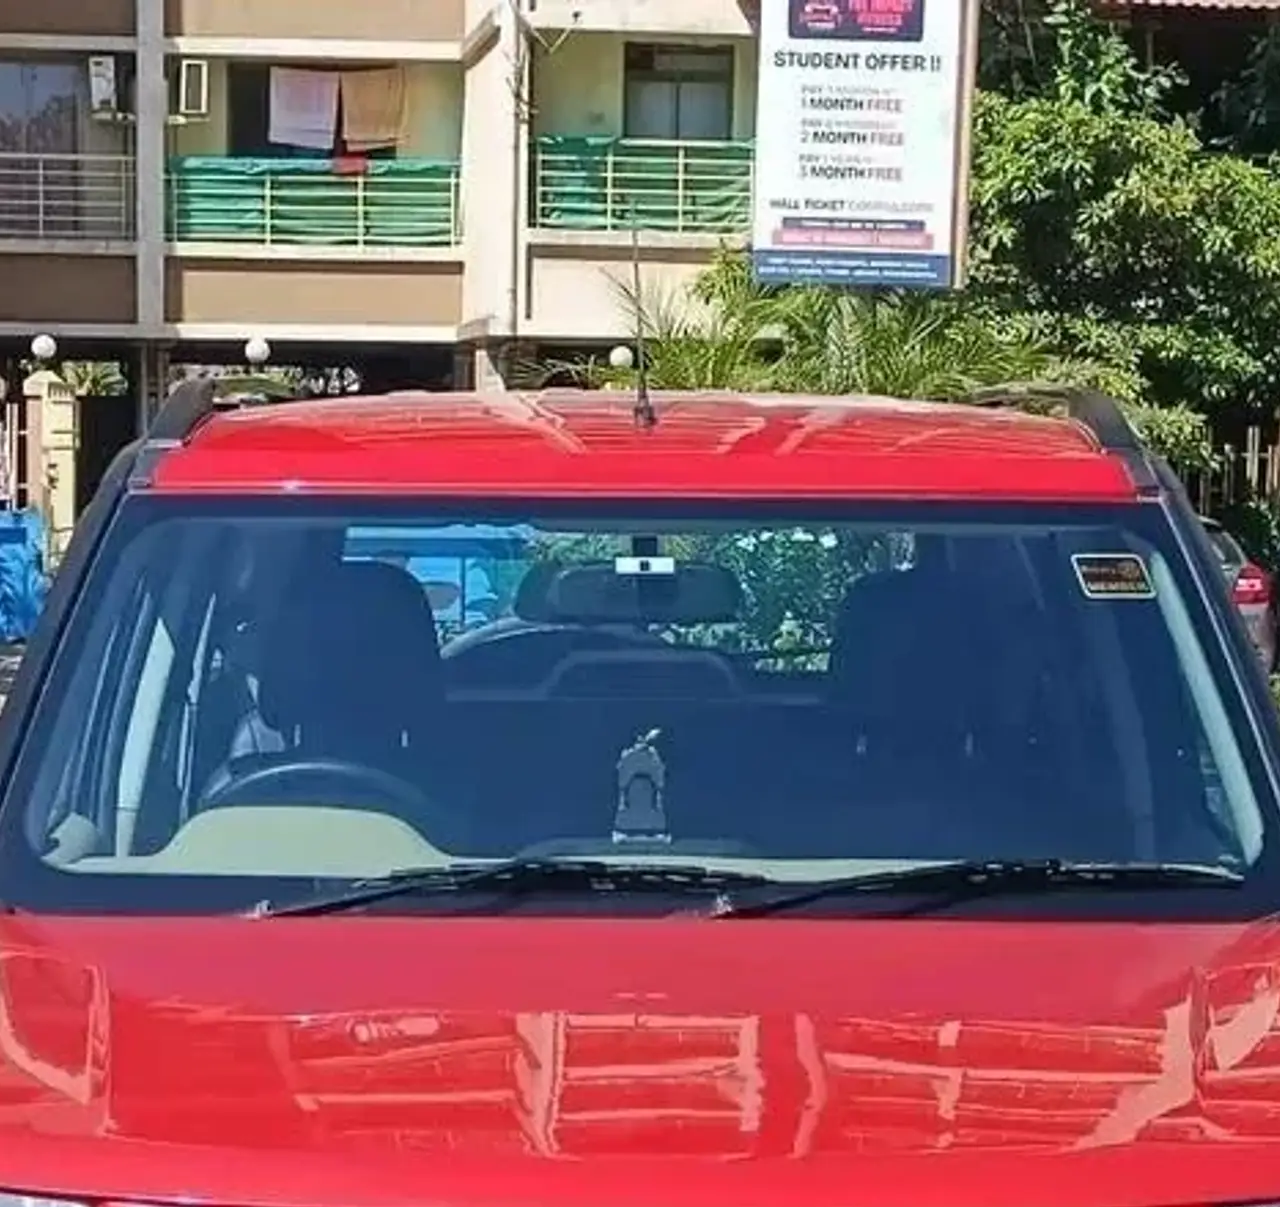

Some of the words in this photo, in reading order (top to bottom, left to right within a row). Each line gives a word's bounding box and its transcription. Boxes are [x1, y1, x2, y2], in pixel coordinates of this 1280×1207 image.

[774, 51, 861, 70] STUDENT
[865, 53, 926, 71] OFFER
[810, 98, 864, 112] MONTH
[812, 131, 867, 145] MONTH
[810, 165, 864, 180] MONTH
